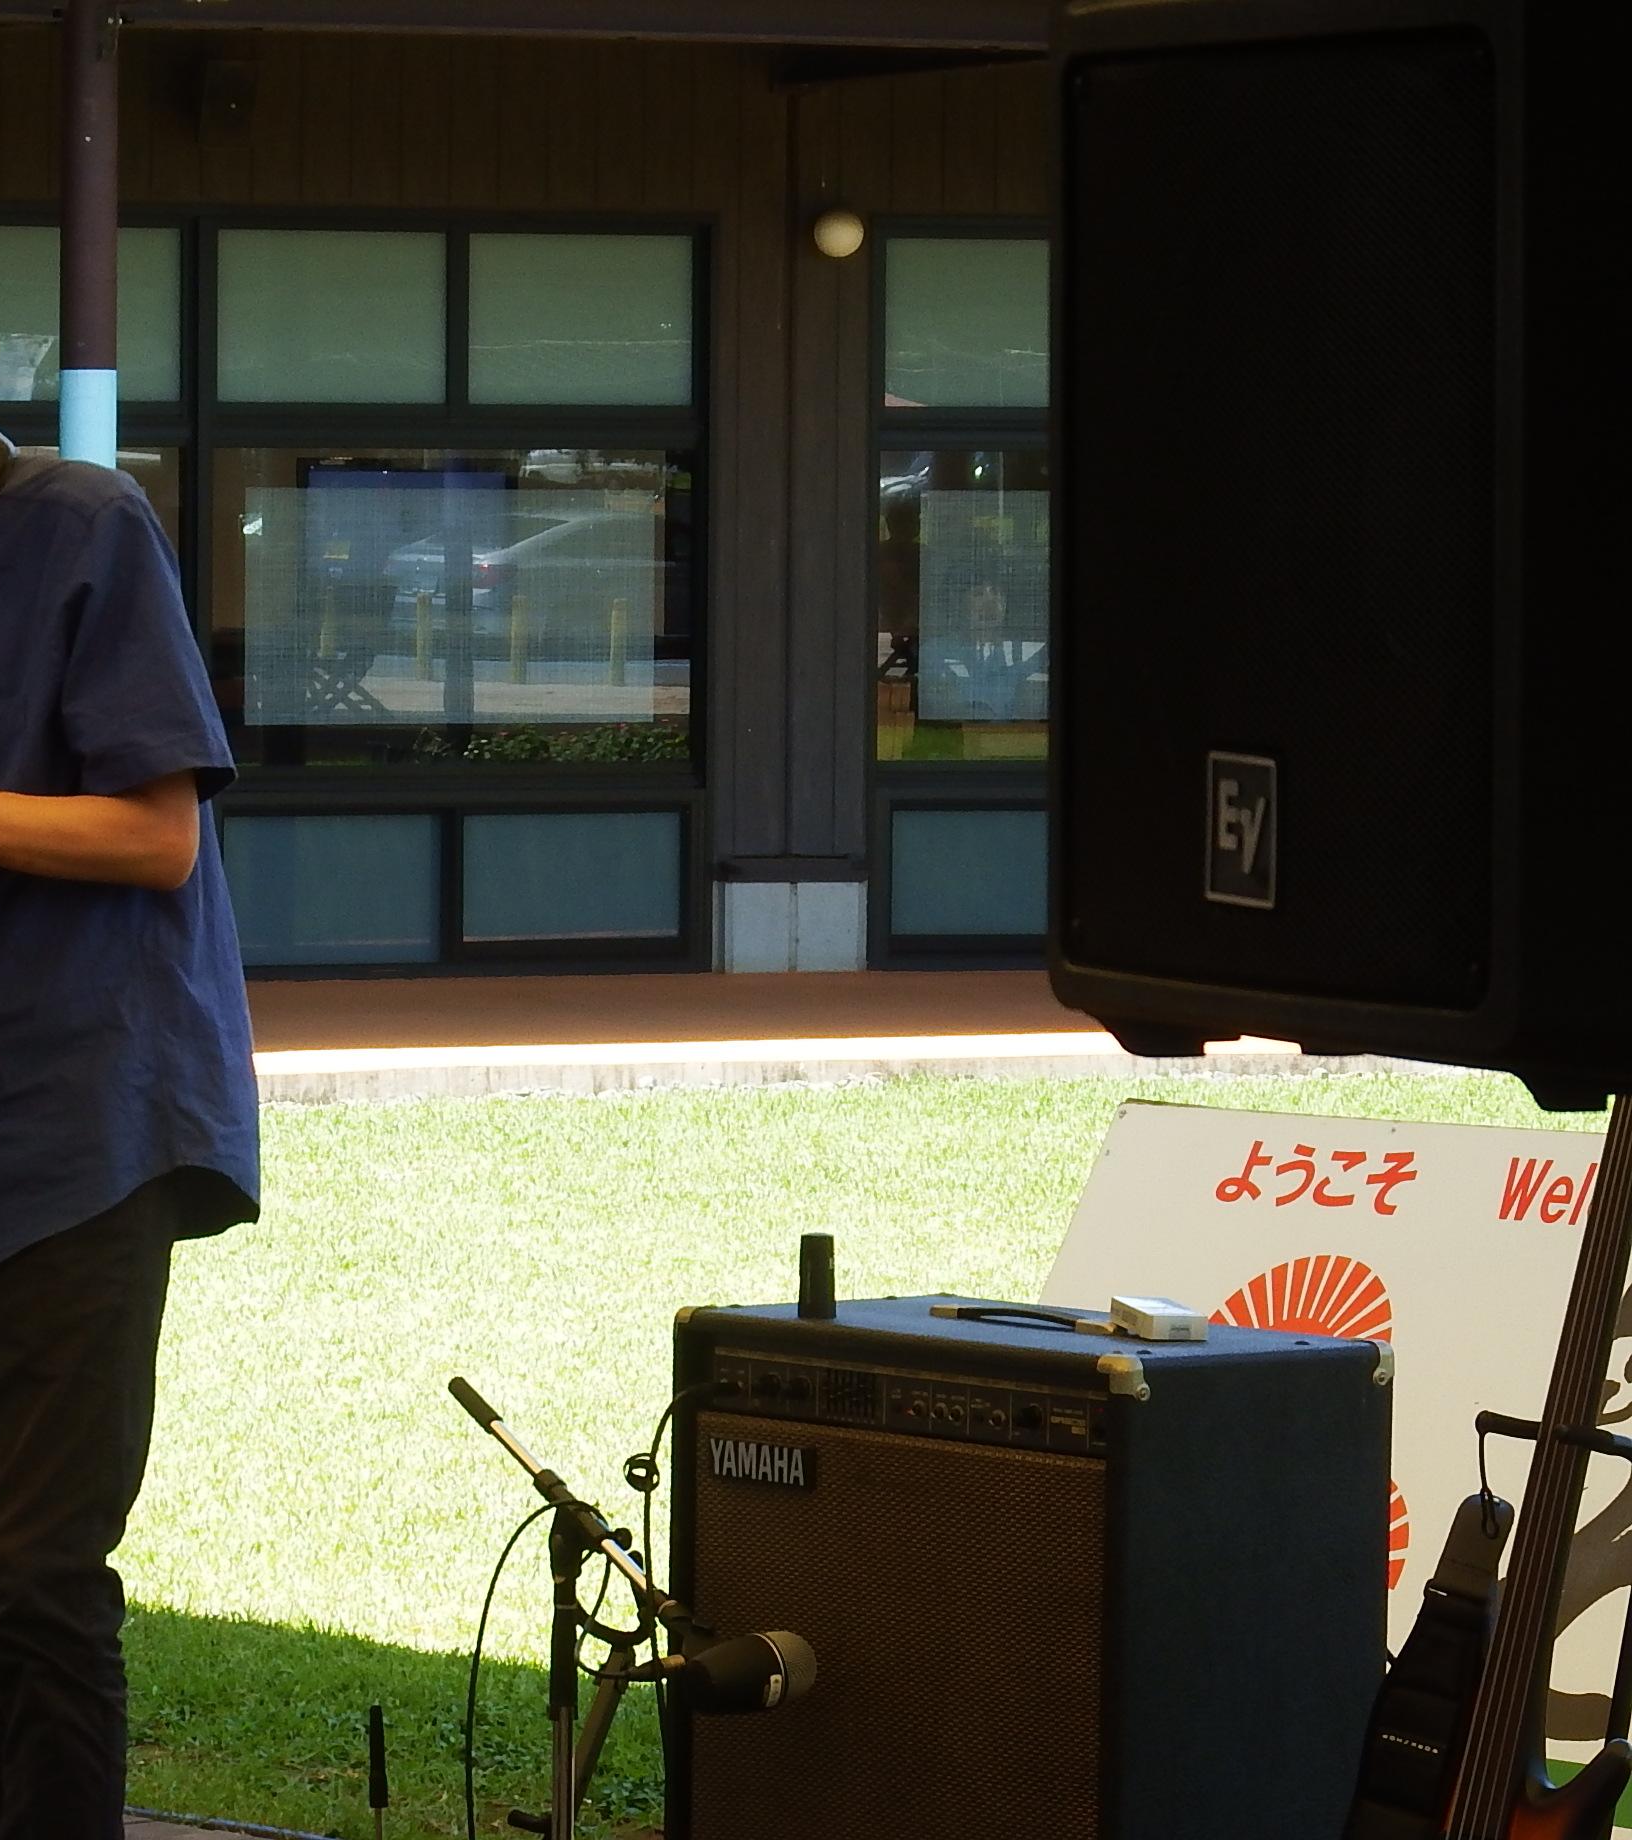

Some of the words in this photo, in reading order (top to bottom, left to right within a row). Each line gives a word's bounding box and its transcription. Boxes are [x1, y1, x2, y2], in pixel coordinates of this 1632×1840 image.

[1215, 1140, 1418, 1216] ようこそ
[1498, 1157, 1599, 1226] Wel
[710, 1438, 804, 1486] YAMAHA
